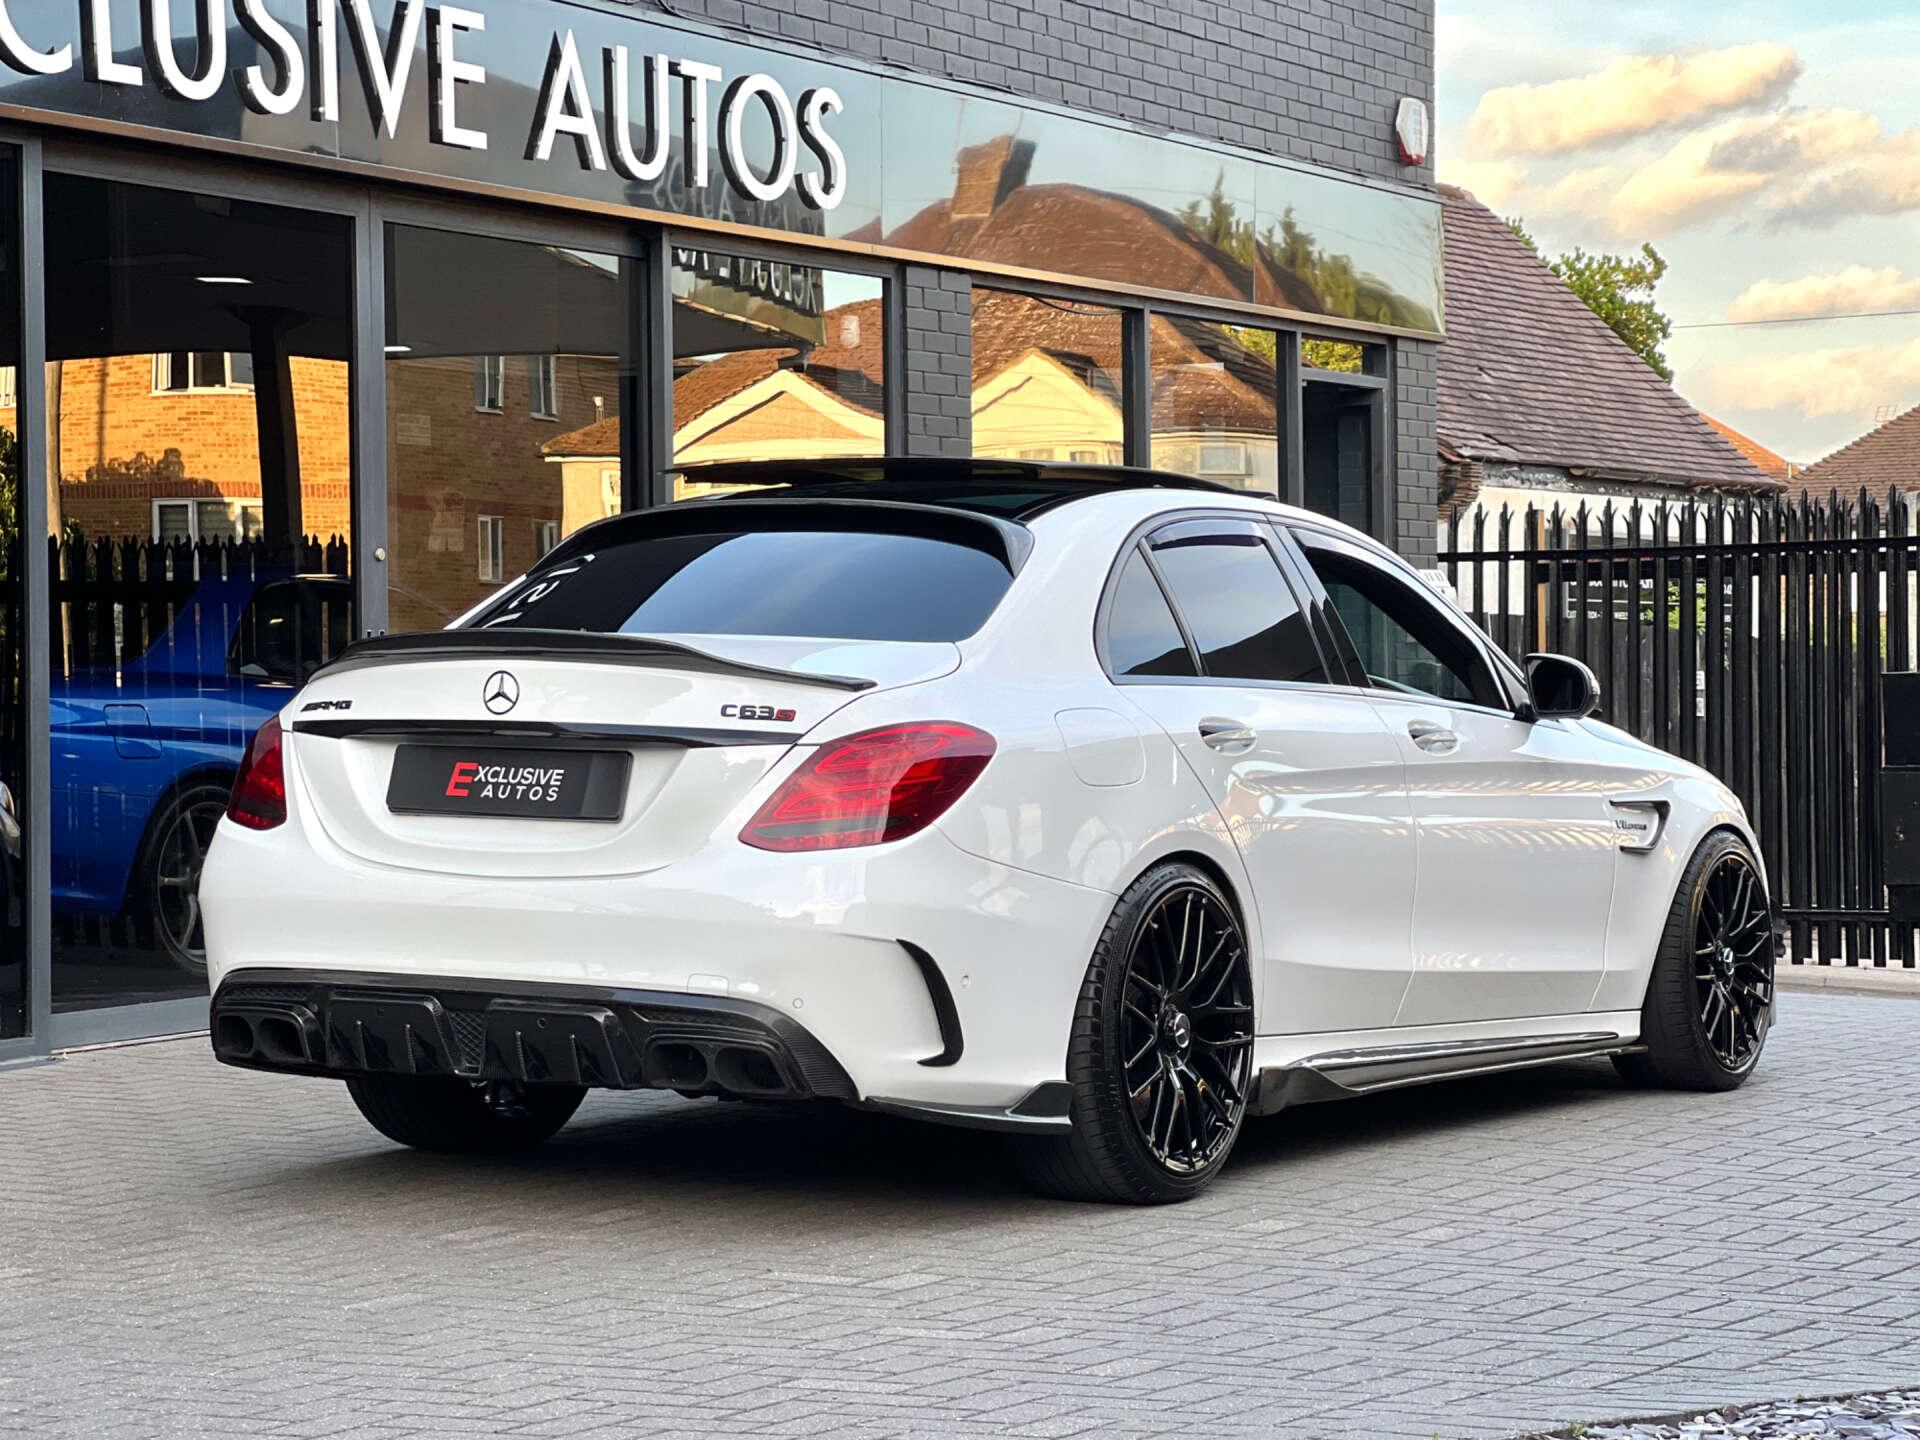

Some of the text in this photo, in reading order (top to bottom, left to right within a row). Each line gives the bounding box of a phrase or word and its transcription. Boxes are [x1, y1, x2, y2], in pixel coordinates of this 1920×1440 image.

[536, 29, 847, 210] AUTOS
[446, 761, 565, 797] EXCLUSIVE
[480, 784, 560, 801] AUTOS
